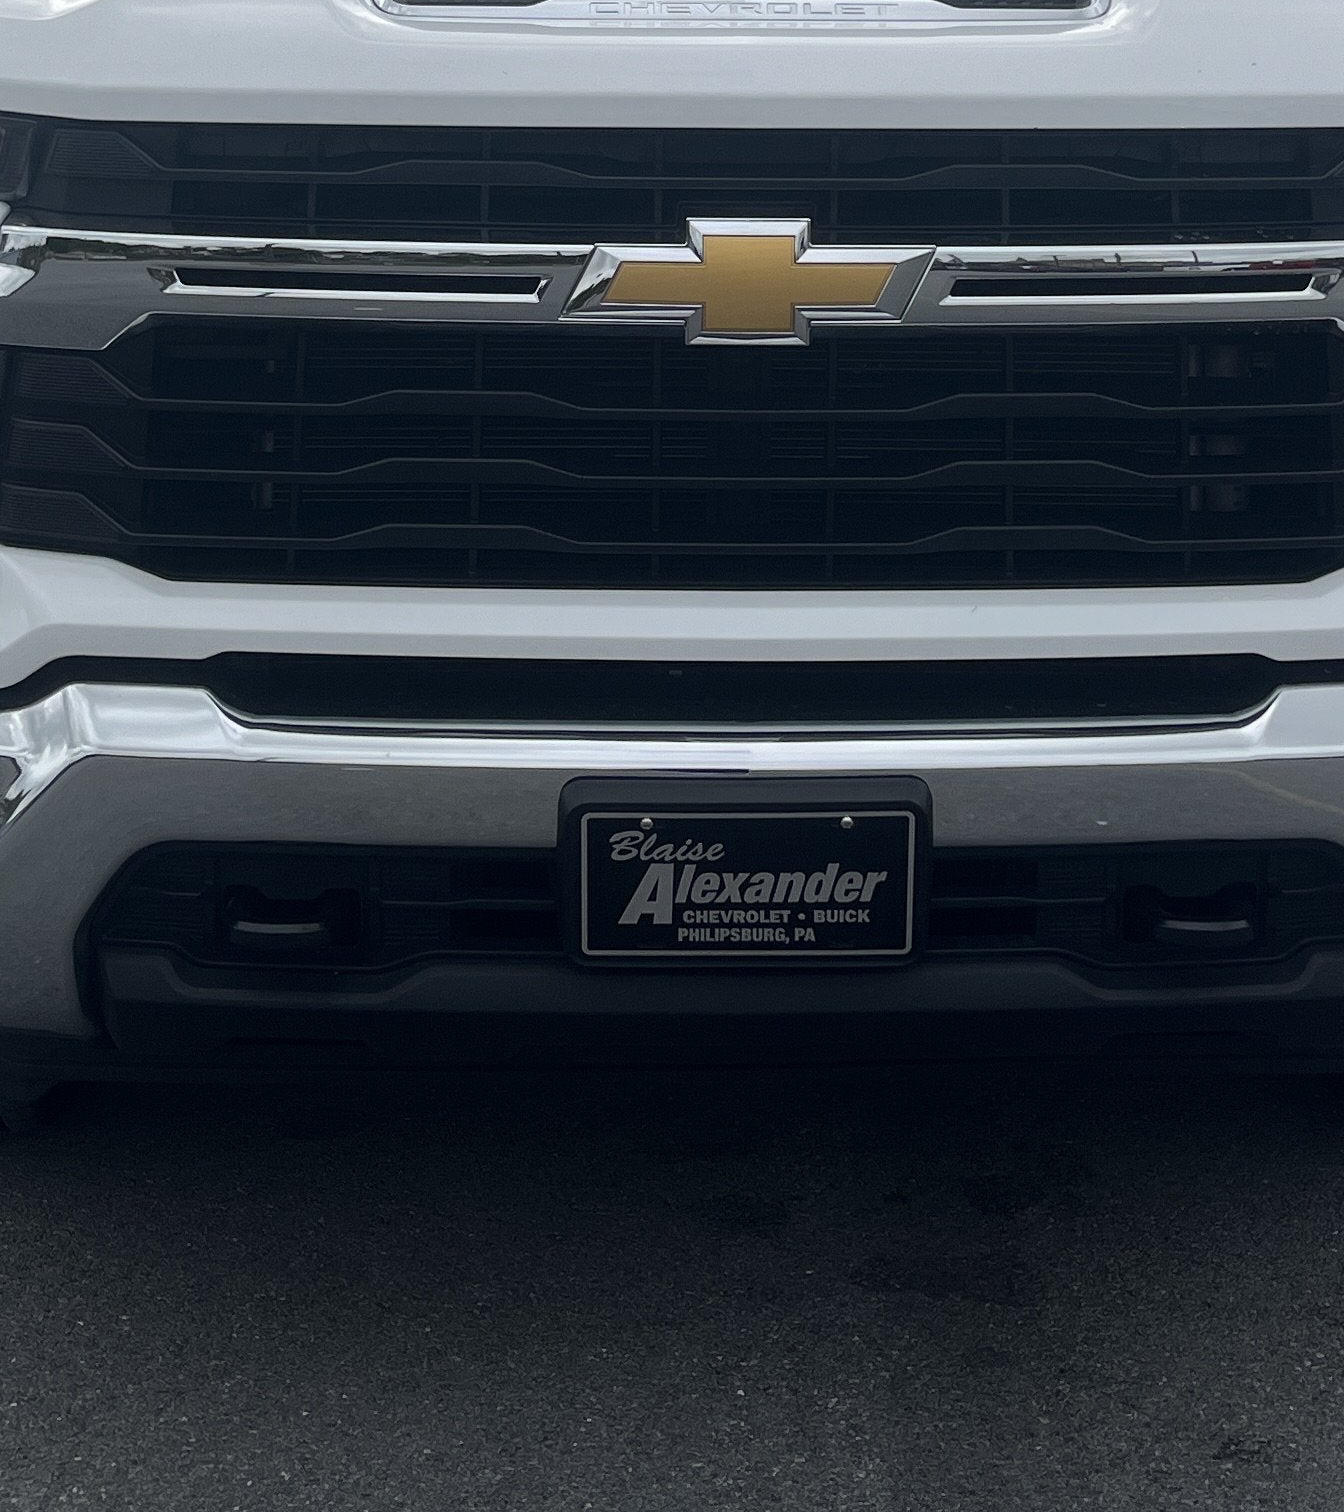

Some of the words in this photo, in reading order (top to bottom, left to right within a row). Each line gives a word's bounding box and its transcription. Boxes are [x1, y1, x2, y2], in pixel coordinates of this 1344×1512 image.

[589, 2, 899, 15] CHEVROLET
[609, 830, 726, 862] Blaise
[618, 862, 888, 925] Alexander
[682, 909, 791, 924] CHEVROLET
[813, 909, 870, 924] BUICK
[677, 927, 790, 945] PHILIPSBURG,
[794, 928, 816, 943] PA
